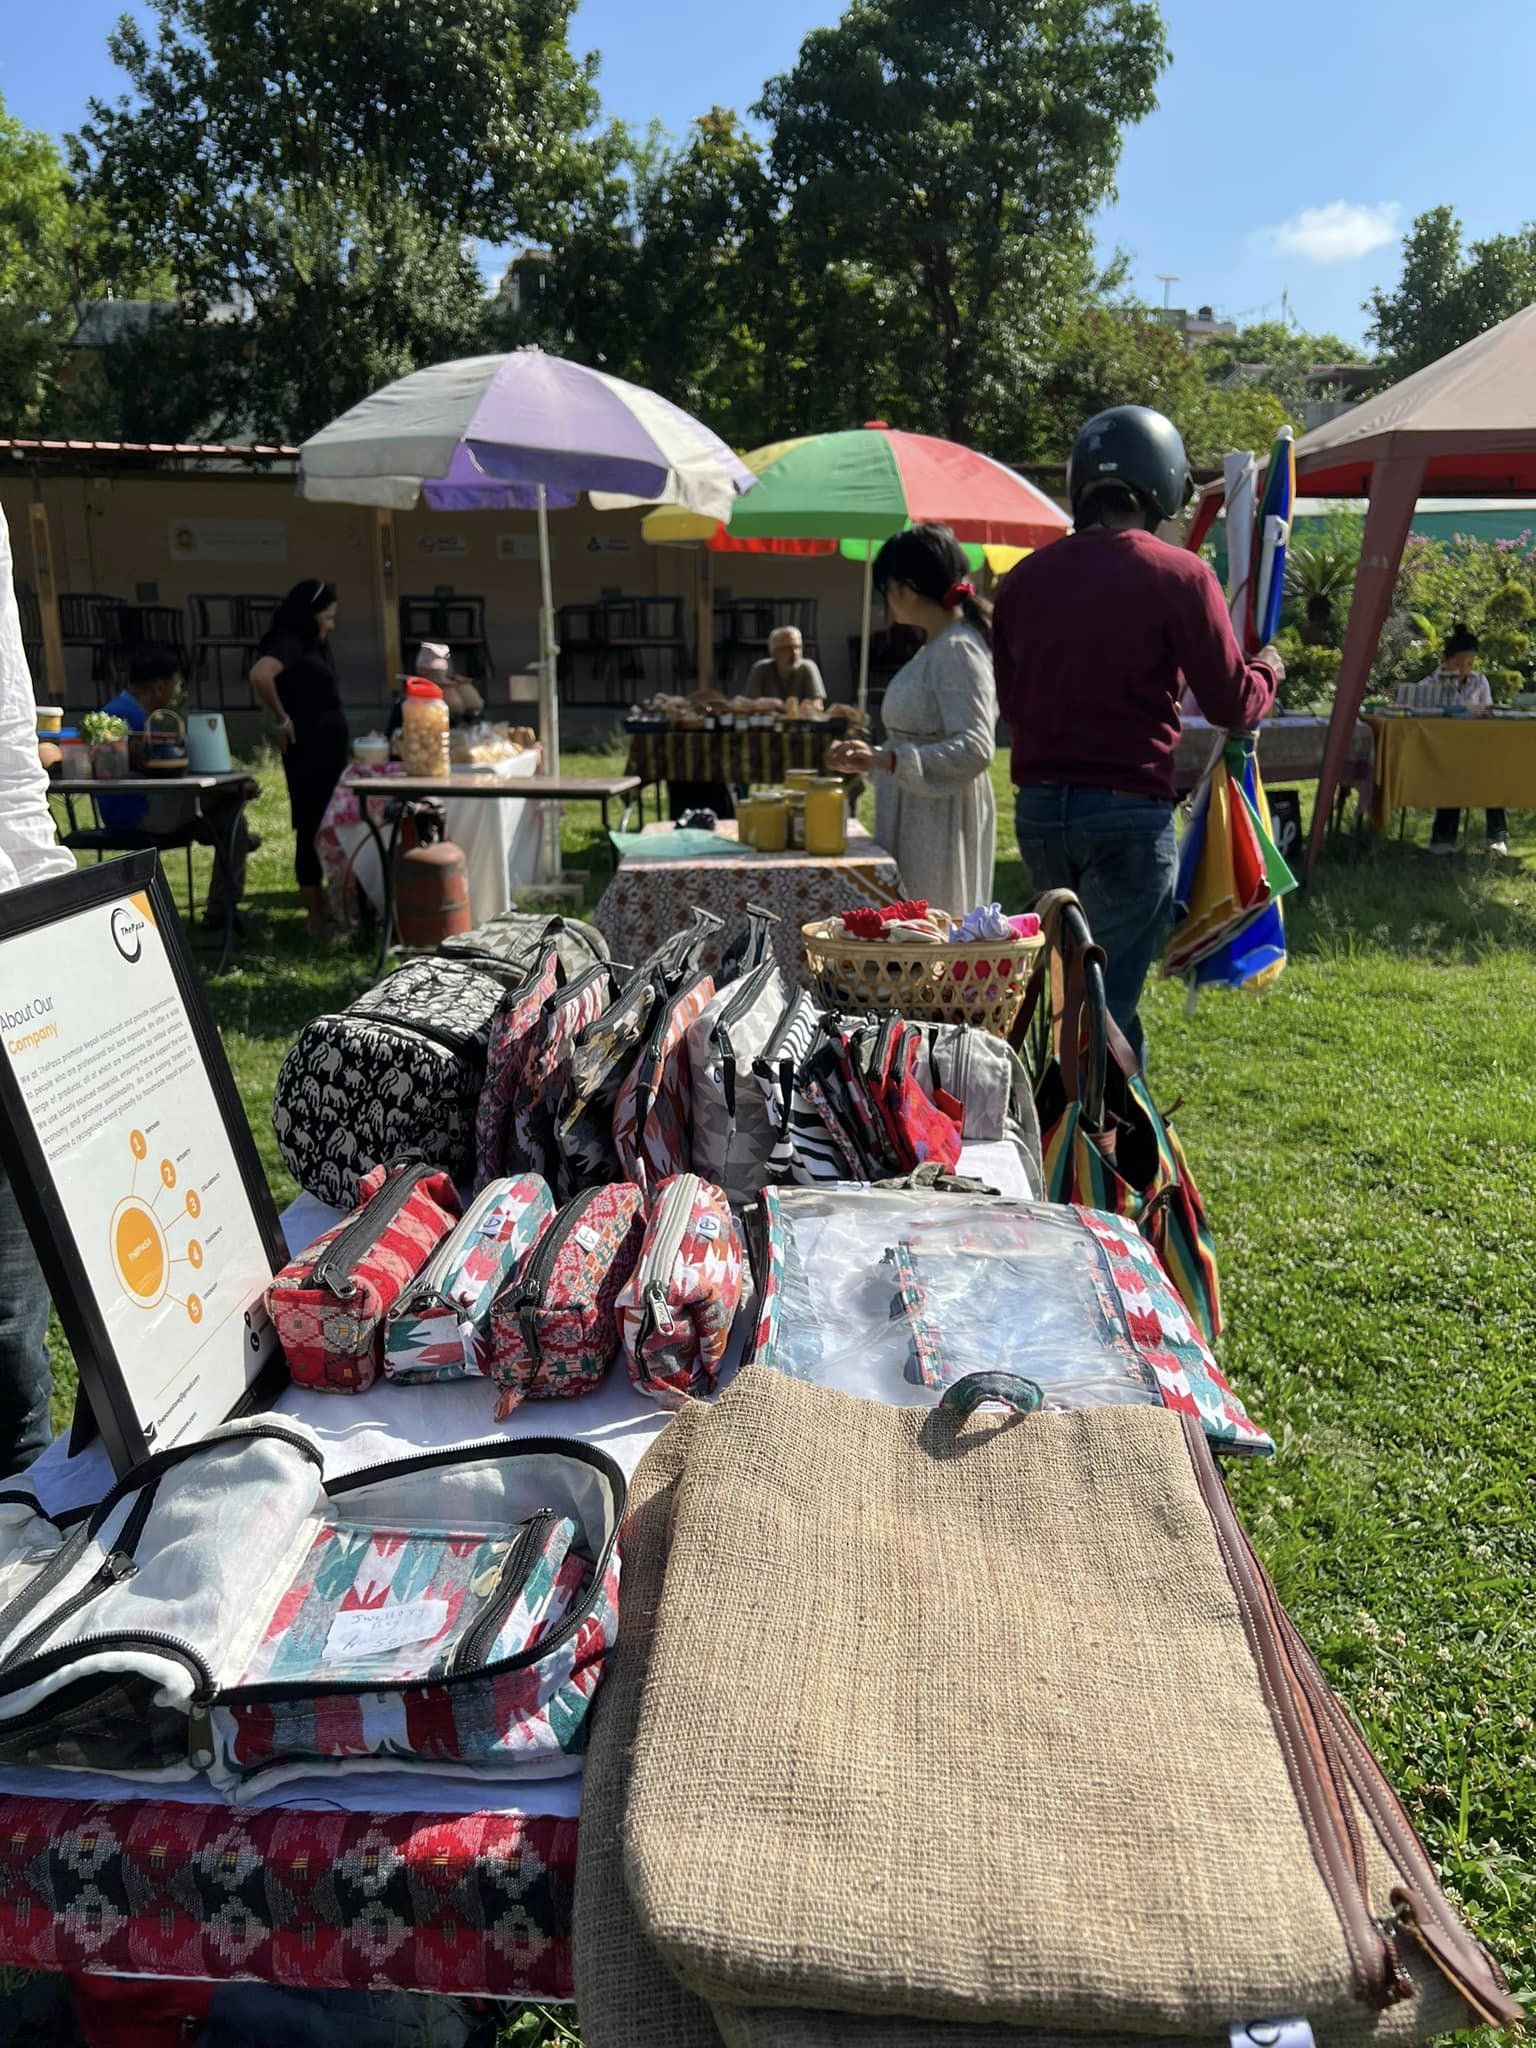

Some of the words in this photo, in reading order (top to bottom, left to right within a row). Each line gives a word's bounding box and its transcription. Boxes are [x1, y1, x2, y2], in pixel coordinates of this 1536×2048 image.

[0, 1003, 34, 1032] About
[33, 996, 55, 1015] Our
[8, 1021, 59, 1055] Company
